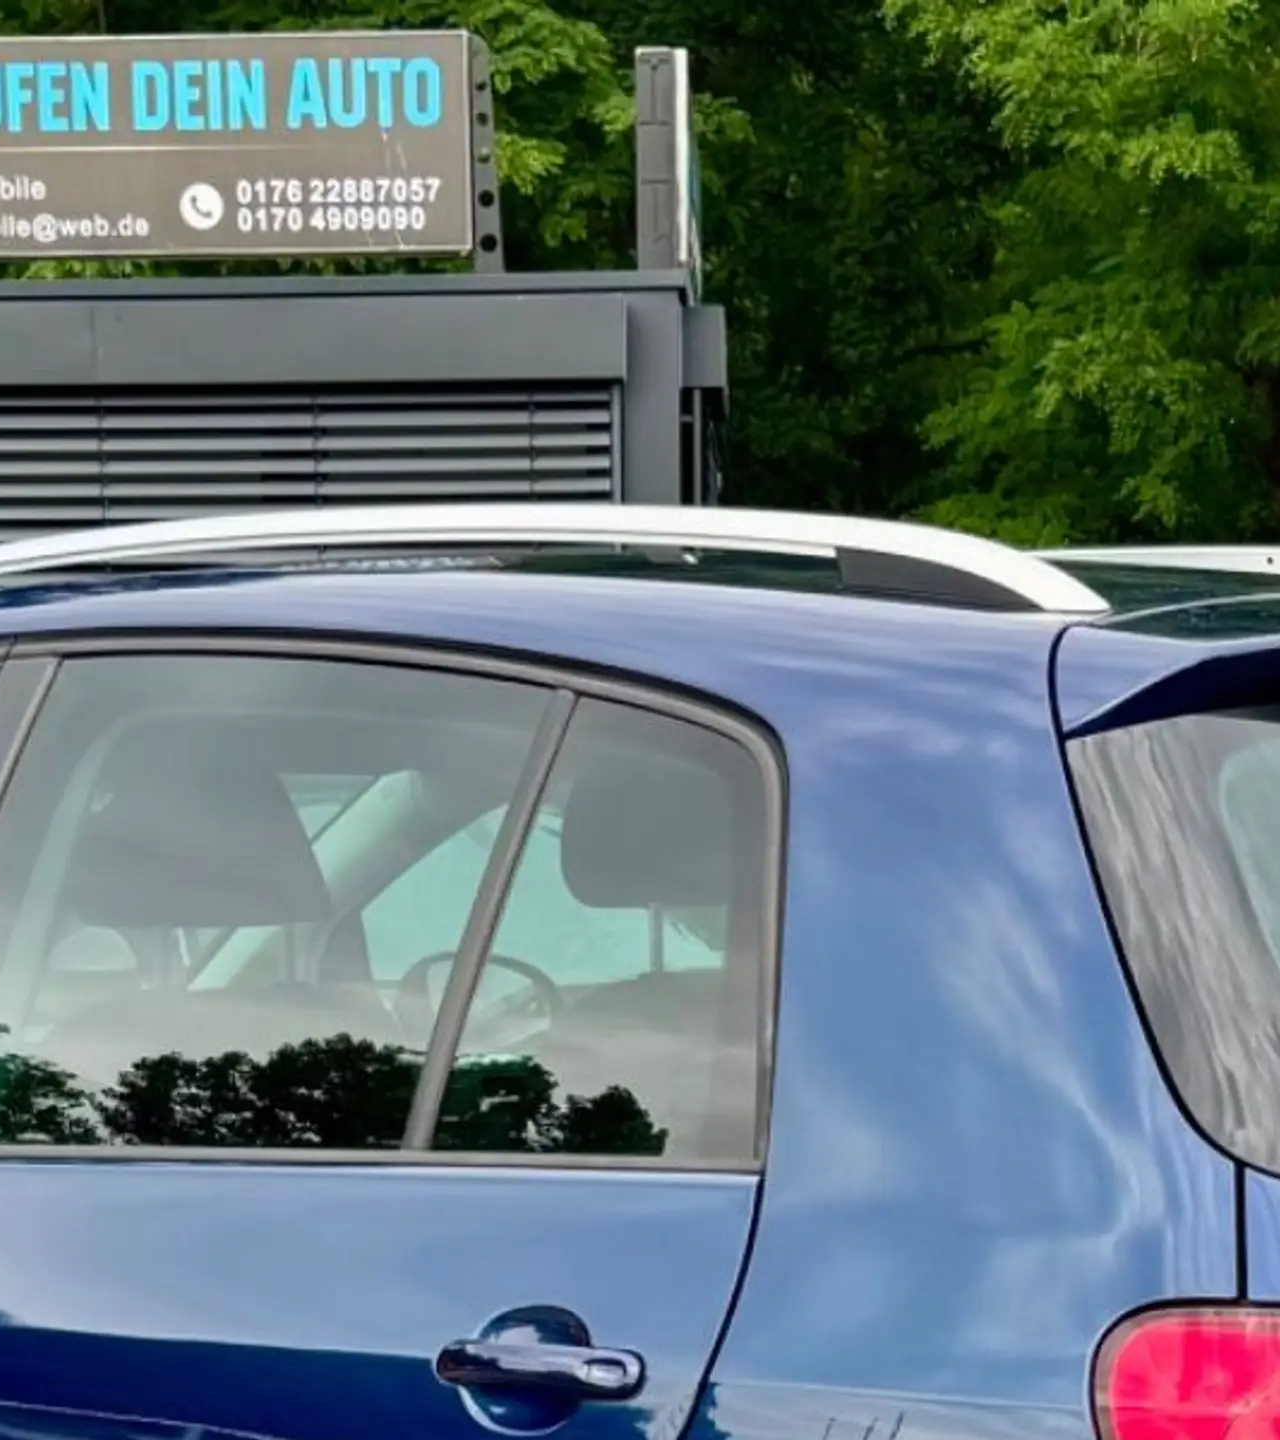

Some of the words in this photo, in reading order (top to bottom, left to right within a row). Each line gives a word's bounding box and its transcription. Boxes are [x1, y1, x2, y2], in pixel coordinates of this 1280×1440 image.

[131, 60, 266, 130] DEIN
[287, 57, 441, 127] AUTO
[236, 179, 302, 203] 0176
[309, 178, 441, 202] 22887057
[237, 207, 303, 231] 0170
[310, 206, 425, 231] 4909090
